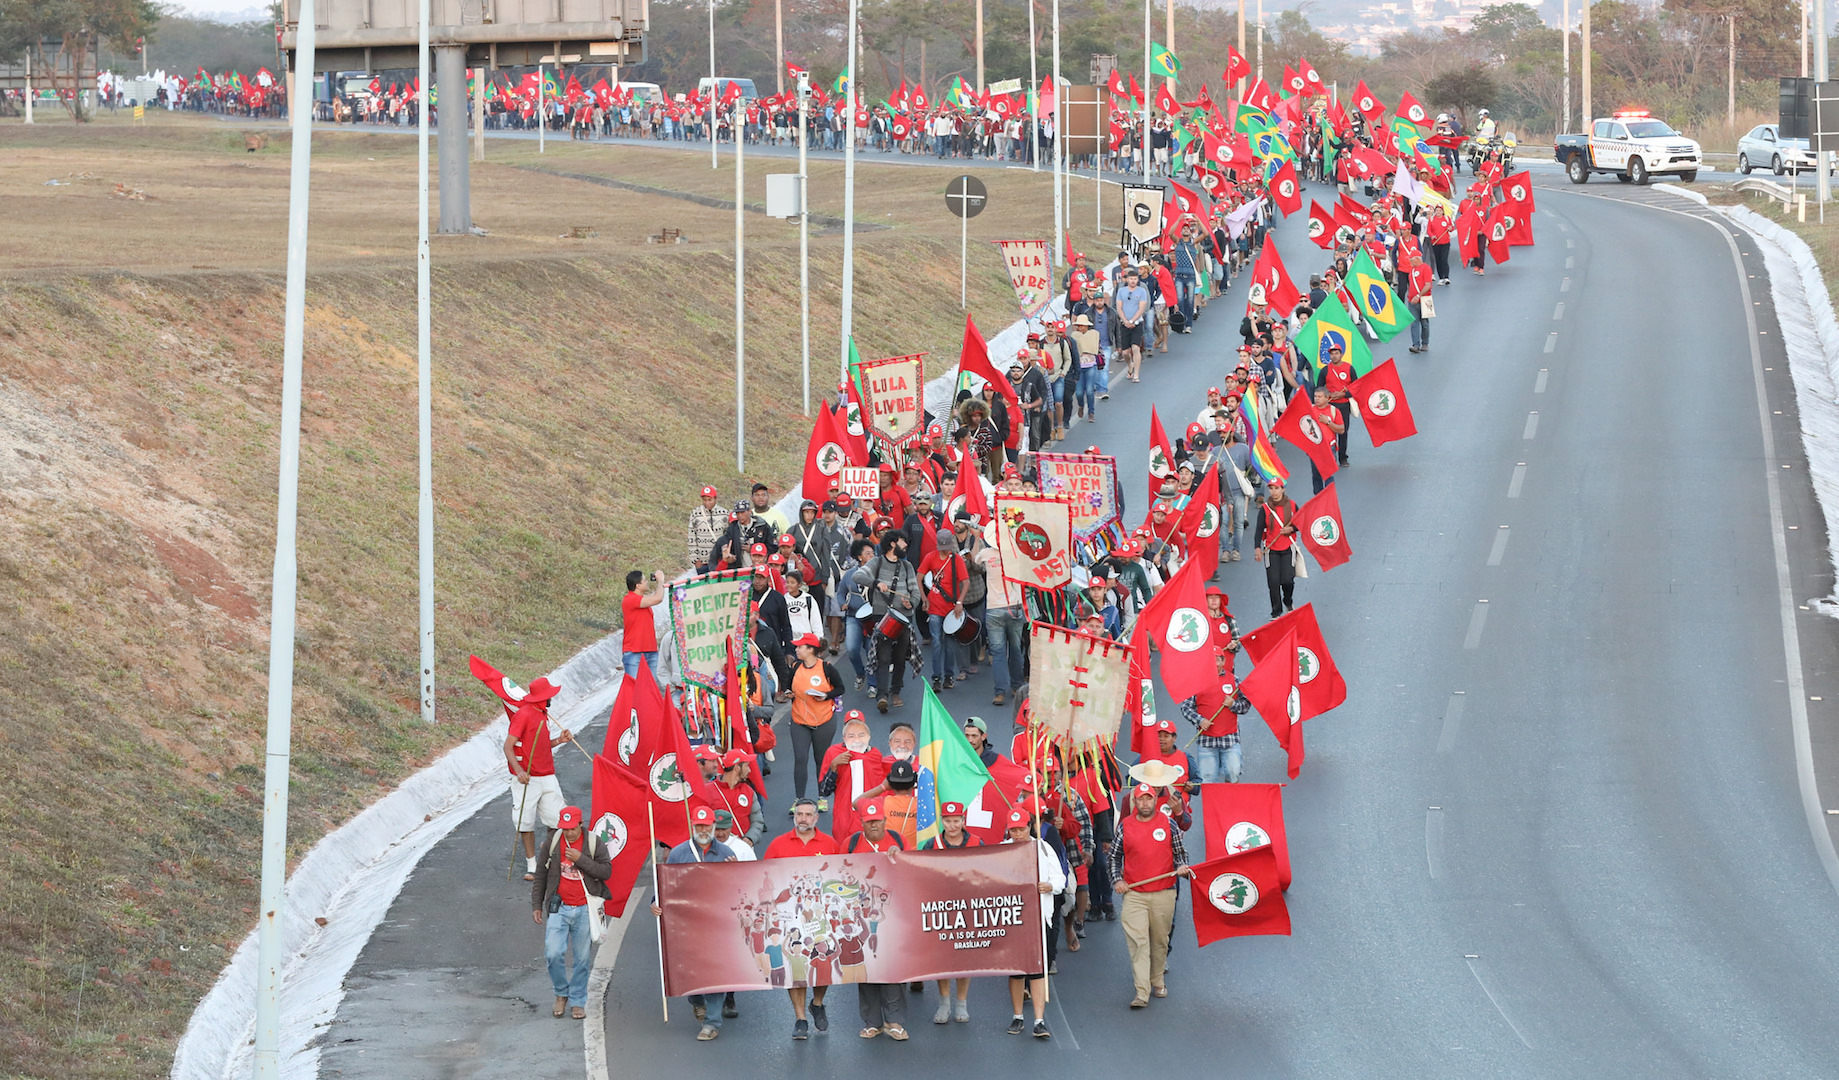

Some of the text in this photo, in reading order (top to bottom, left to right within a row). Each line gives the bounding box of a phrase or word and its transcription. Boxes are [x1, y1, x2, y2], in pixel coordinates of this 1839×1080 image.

[872, 376, 908, 394] LULA
[874, 396, 916, 415] LIVRE
[844, 469, 879, 485] LULA
[1055, 463, 1101, 477] BLOCO
[1069, 477, 1101, 491] VEM
[1032, 548, 1070, 584] MST
[681, 591, 741, 617] FRENTE
[687, 641, 731, 664] POPU
[921, 894, 1024, 913] MARCHA NACIONAL
[922, 905, 1023, 931] LULA LIVRE
[938, 928, 1006, 940] 10 A 15 DE AGOSTO
[954, 939, 991, 950] BRASÍLIA/DF
